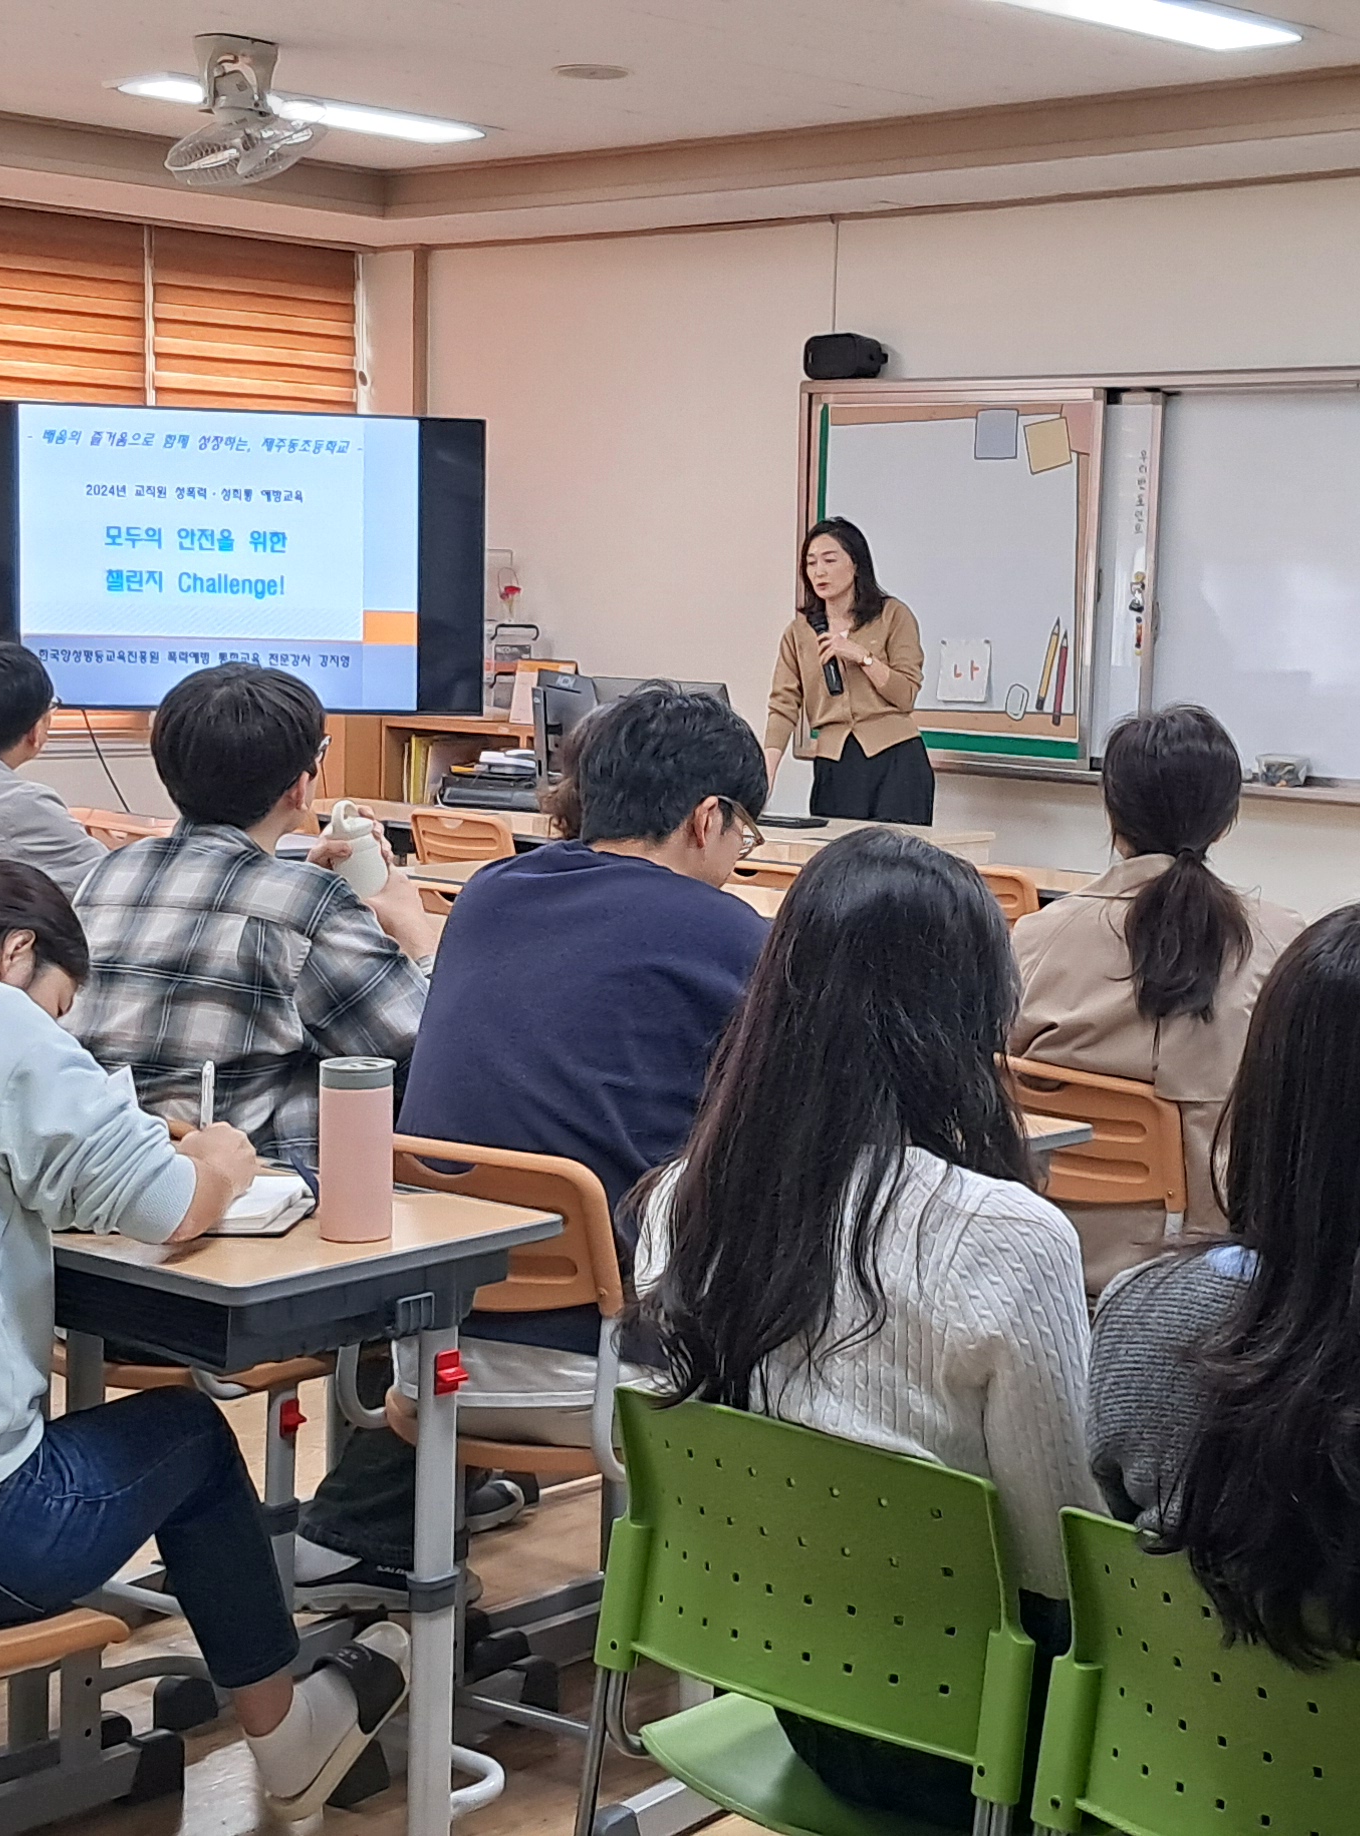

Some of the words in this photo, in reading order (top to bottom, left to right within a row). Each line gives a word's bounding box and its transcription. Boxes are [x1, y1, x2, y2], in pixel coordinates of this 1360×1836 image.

[41, 429, 82, 445] 배움의
[90, 431, 155, 447] 즐거움으로
[163, 433, 190, 449] 함께
[86, 484, 127, 498] 2024년
[135, 485, 167, 499] 교직원
[175, 486, 207, 500] 성폭력
[222, 487, 253, 502] 성희롱
[261, 489, 304, 503] 예방교육
[105, 526, 162, 550] 모두의
[177, 528, 235, 551] 안전을
[249, 530, 288, 553] 위한
[106, 568, 163, 593] 챌린지
[178, 571, 285, 600] Challenge!
[168, 650, 210, 665] 폭력예방
[269, 653, 311, 667] 전문강사
[953, 660, 980, 681] 나
